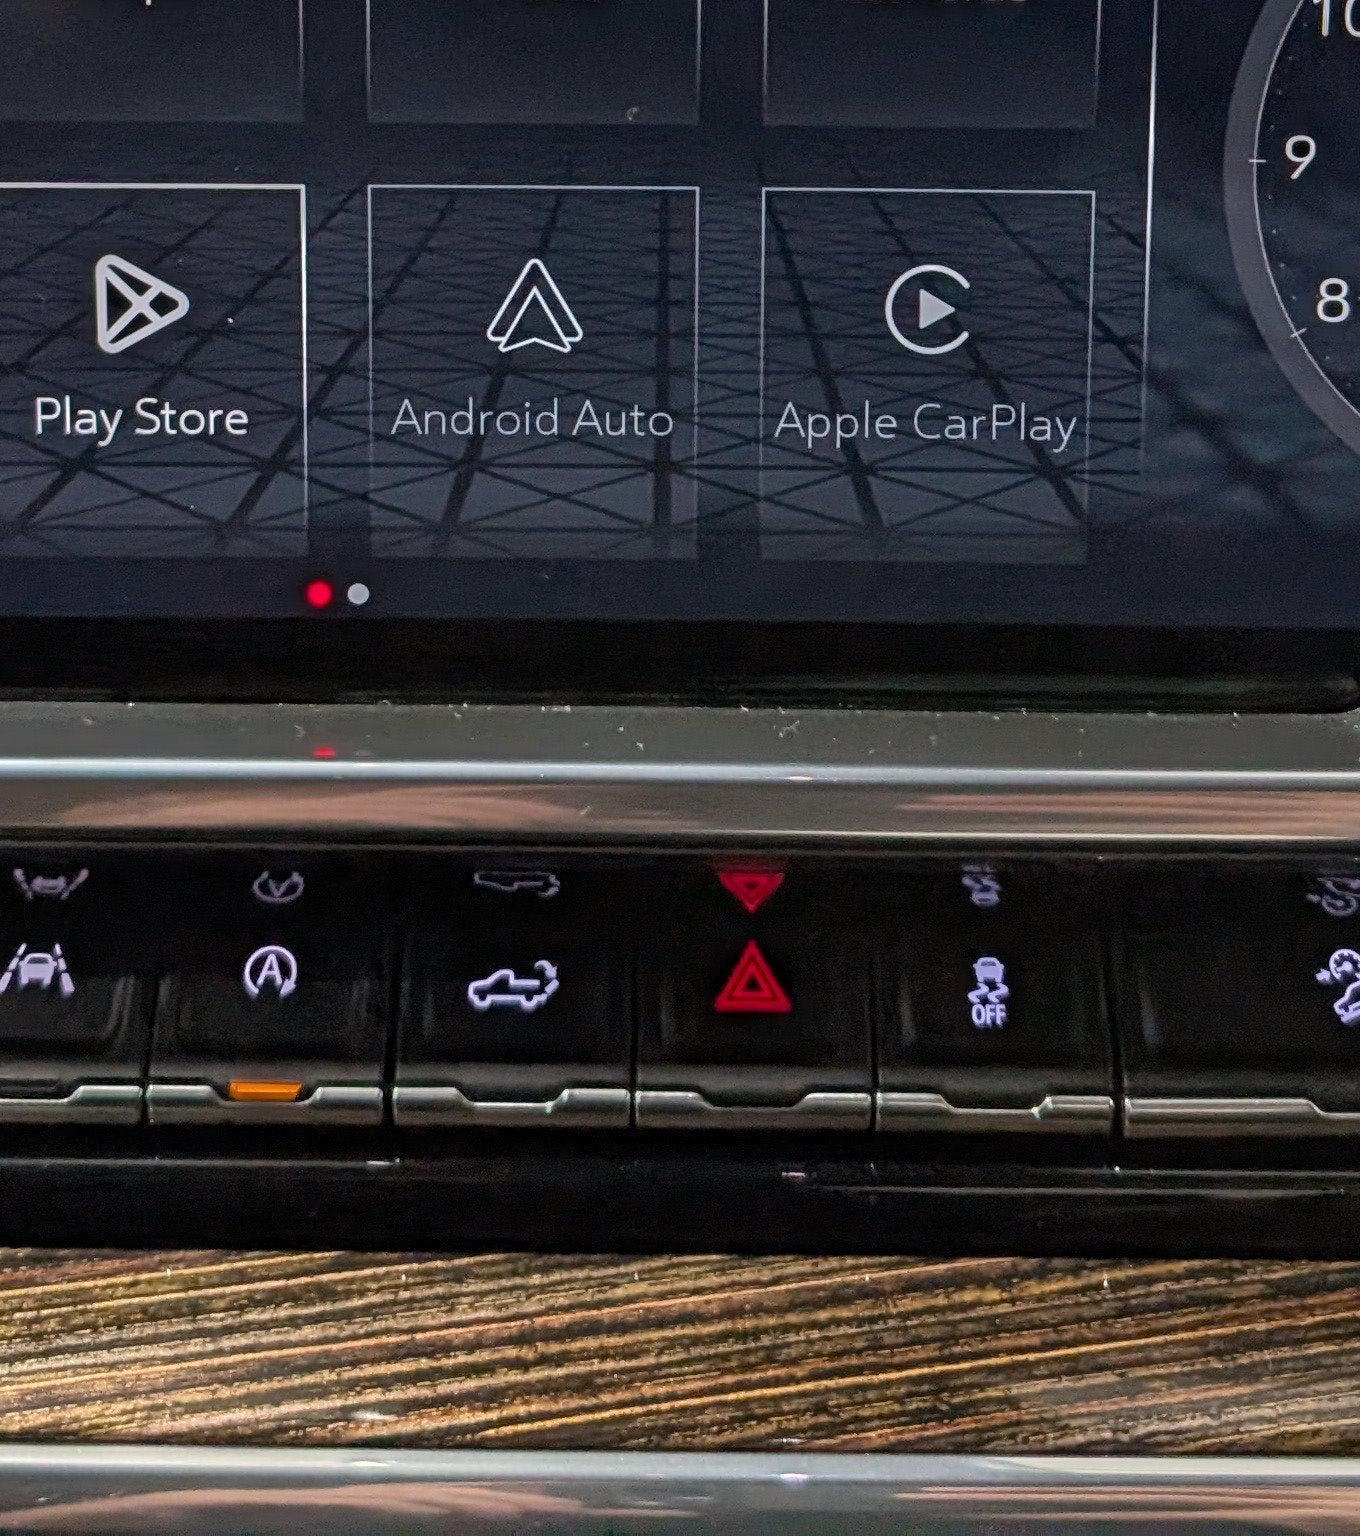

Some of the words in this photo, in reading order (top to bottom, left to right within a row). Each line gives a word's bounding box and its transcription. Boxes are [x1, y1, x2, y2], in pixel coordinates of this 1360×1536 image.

[1285, 134, 1316, 180] 9
[1316, 277, 1351, 323] 8
[36, 394, 124, 447] Play
[134, 397, 249, 435] Store
[390, 396, 558, 436] Android
[571, 399, 674, 437] Auto
[773, 399, 898, 449] Apple
[913, 401, 1077, 454] CarPlay
[257, 953, 283, 987] A
[971, 1003, 1008, 1028] OFF
